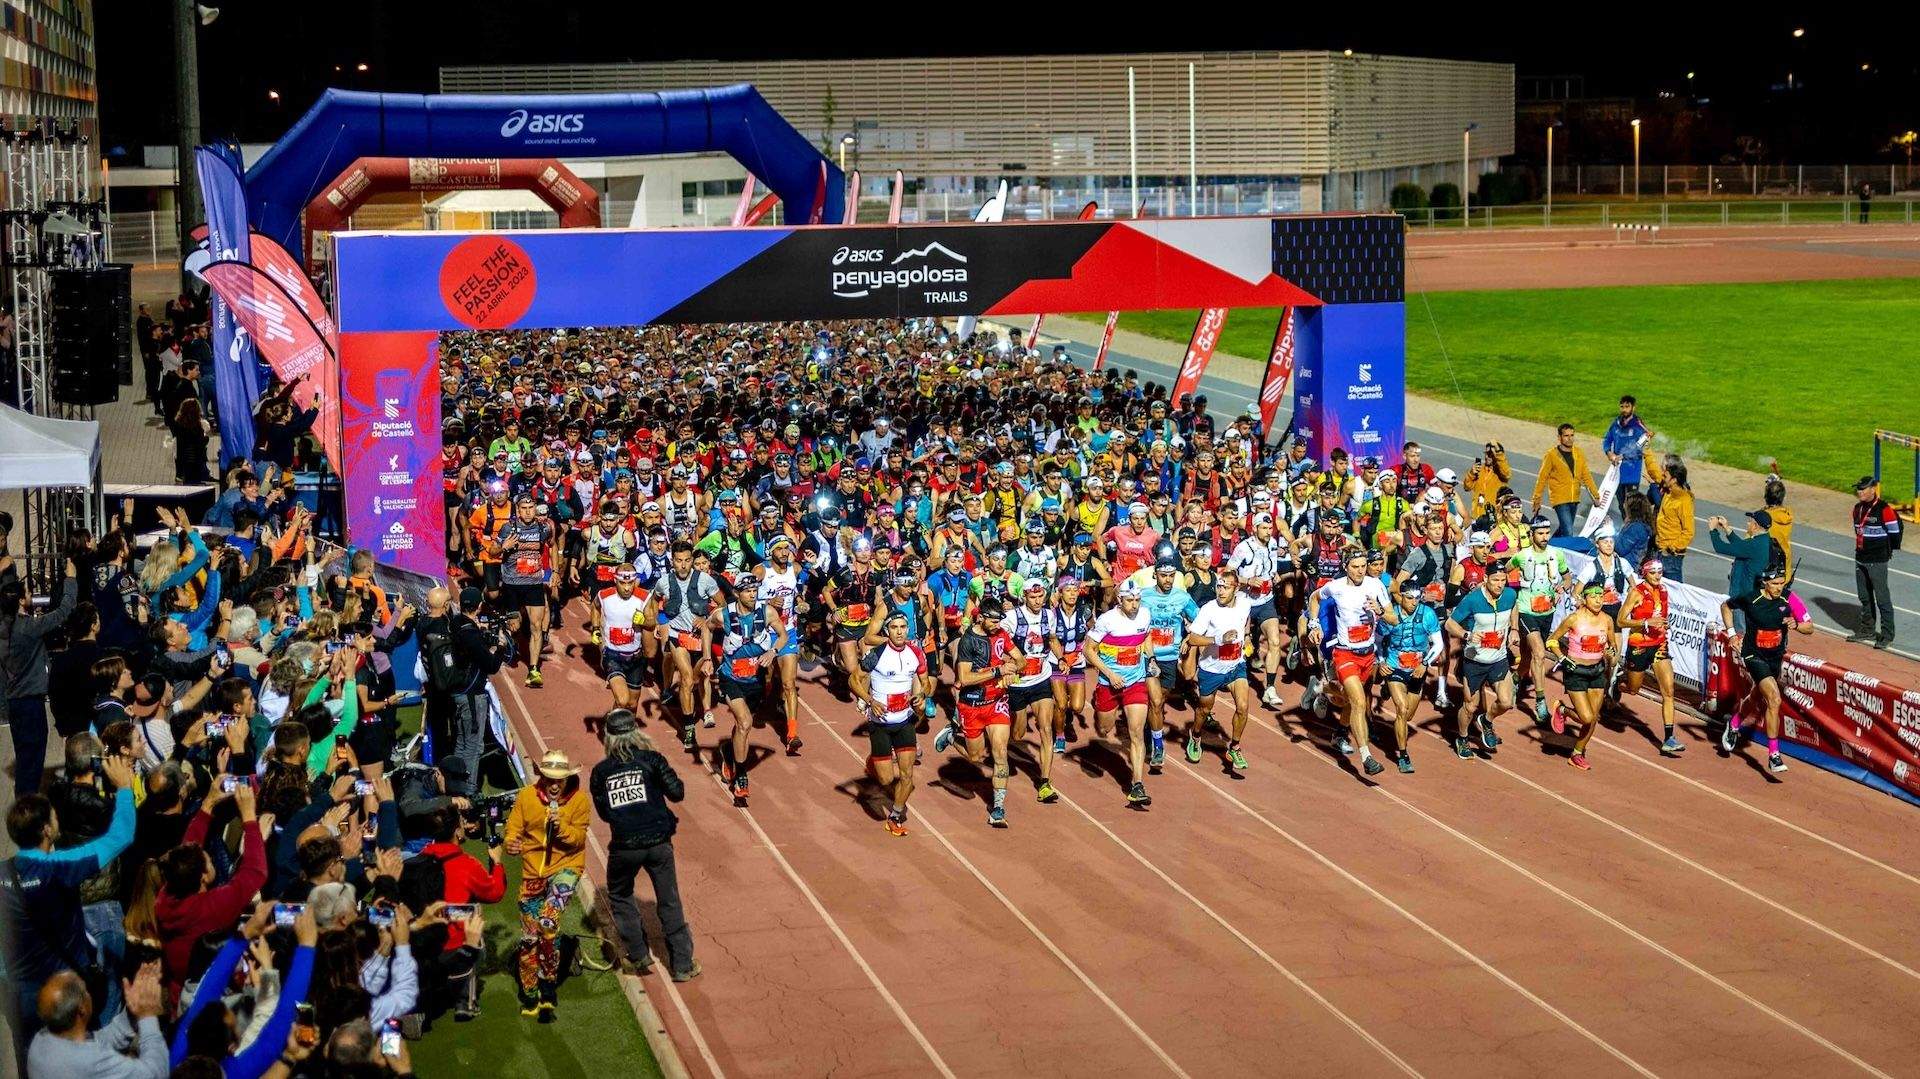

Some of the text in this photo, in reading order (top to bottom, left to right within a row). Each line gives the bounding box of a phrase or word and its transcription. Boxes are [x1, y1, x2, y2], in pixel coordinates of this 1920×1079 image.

[453, 245, 510, 305] FEEL THE
[464, 256, 520, 316] PASSION
[832, 265, 968, 291] penyagolosa
[475, 266, 529, 324] 22 ABRIL 2023
[923, 291, 968, 303] TRAILS
[1348, 385, 1382, 393] Diputació
[1357, 392, 1384, 400] Castelló
[371, 429, 414, 438] de Castelló
[372, 421, 412, 431] Diputació
[1668, 612, 1705, 635] MUNITAT
[1670, 630, 1702, 651] L'ESPOR
[1780, 660, 1828, 695] ESCENARIO
[1836, 679, 1884, 715] ESCENARIO
[1893, 699, 1920, 731] ESCE
[608, 774, 643, 791] Trail
[611, 787, 644, 806] PRESS
